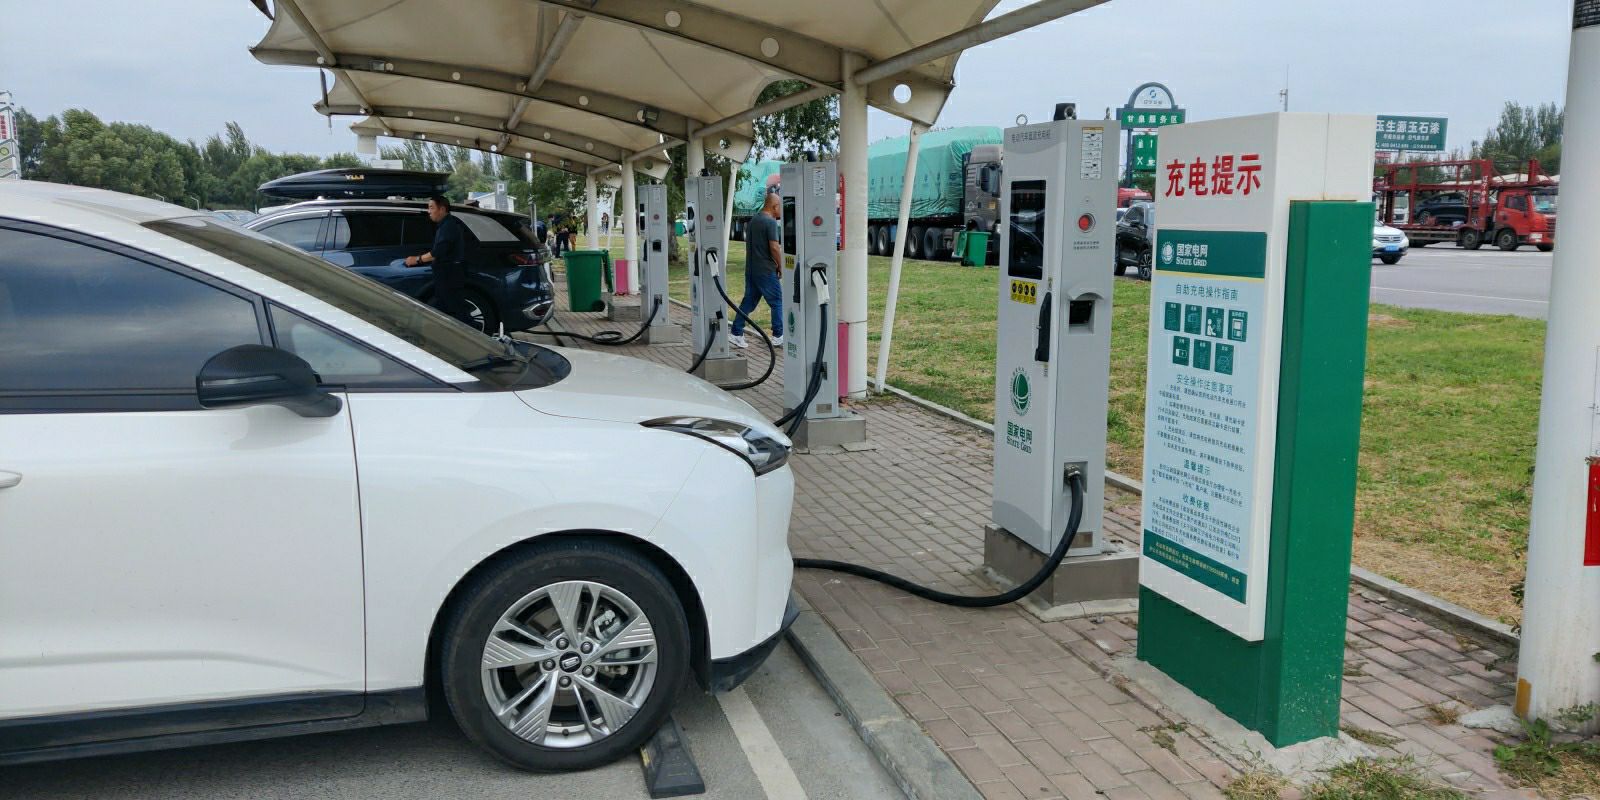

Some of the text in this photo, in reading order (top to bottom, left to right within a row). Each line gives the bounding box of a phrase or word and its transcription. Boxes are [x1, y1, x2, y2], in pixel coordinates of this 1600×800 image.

[1165, 154, 1262, 197] 充电提示
[1176, 243, 1208, 257] 国家电网
[1175, 284, 1239, 301] 自助充电操作指南
[1176, 374, 1233, 396] 安全操作注意事项
[1007, 420, 1032, 444] 国家电网
